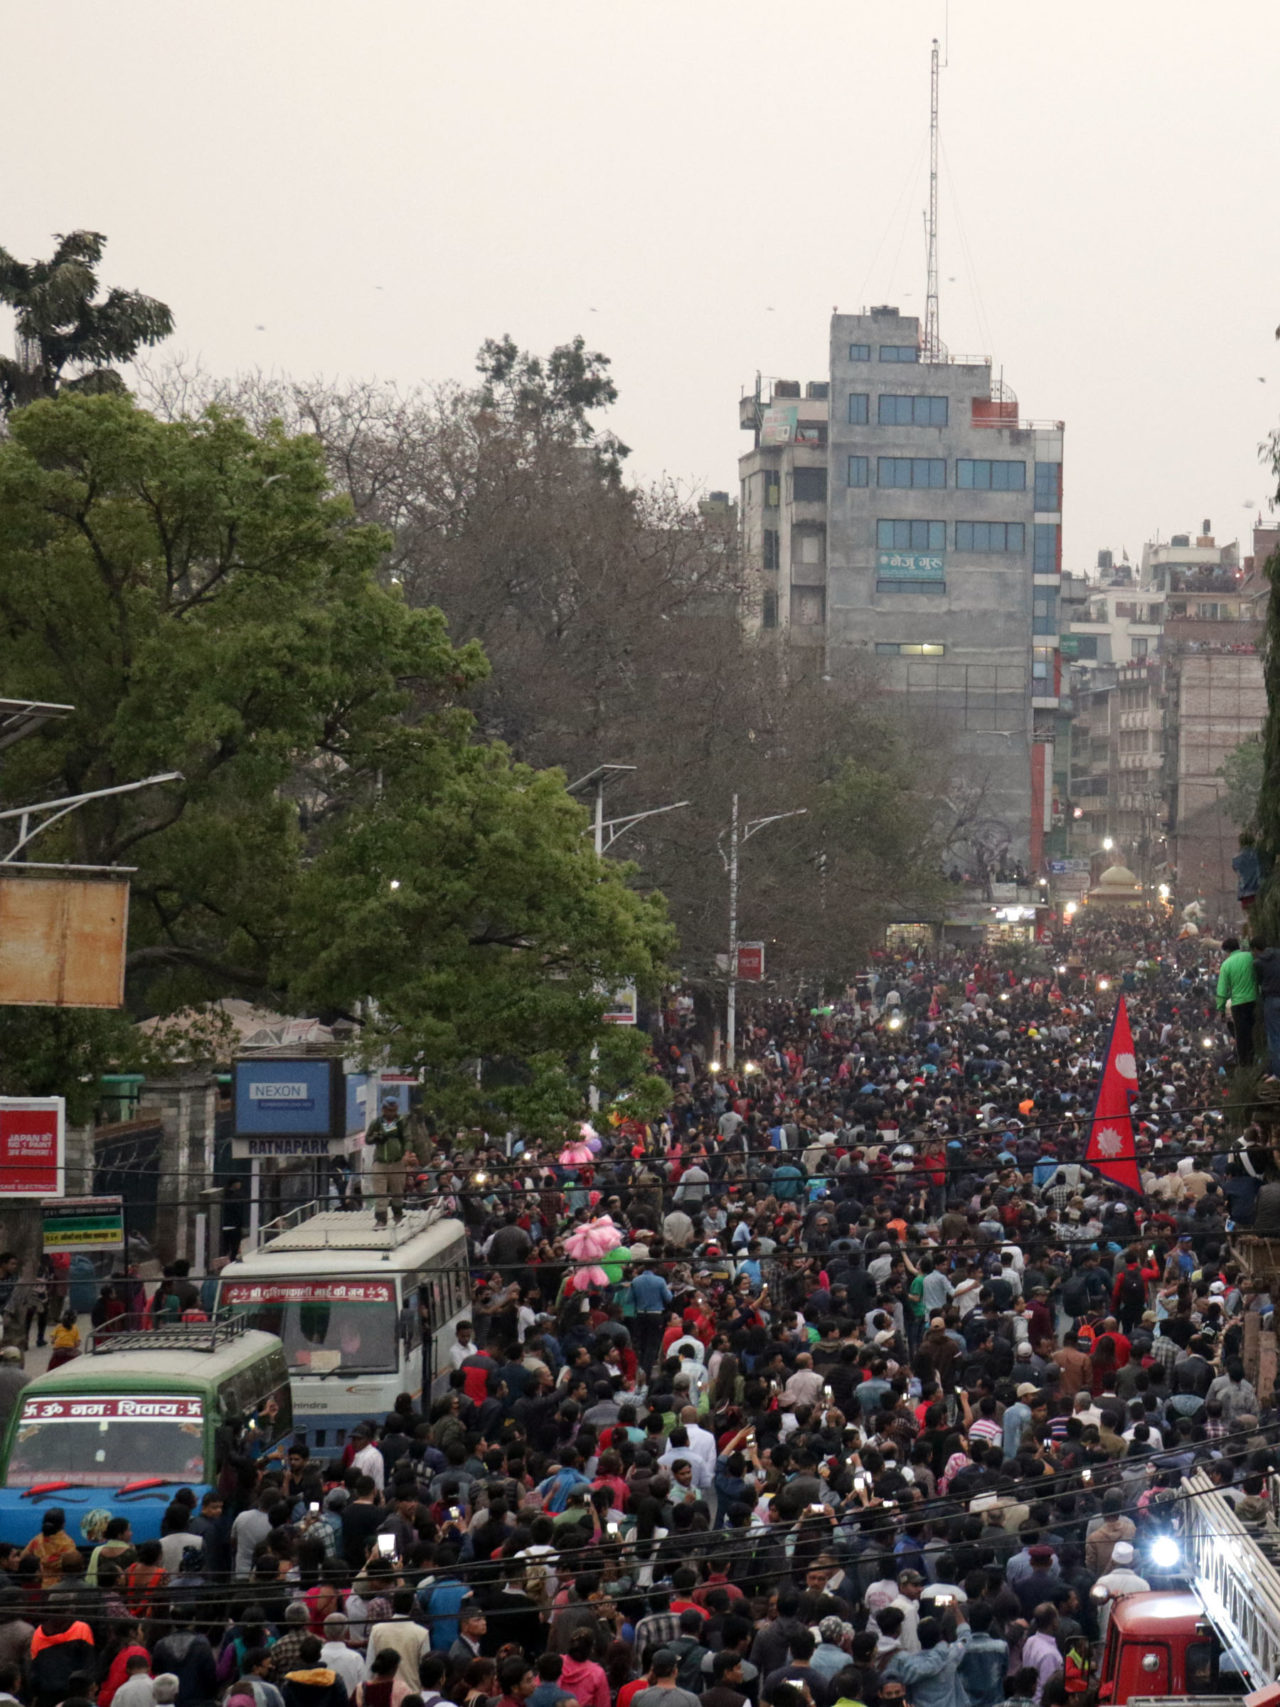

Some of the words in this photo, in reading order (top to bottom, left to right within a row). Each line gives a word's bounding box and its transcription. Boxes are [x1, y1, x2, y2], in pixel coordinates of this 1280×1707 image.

[255, 1085, 302, 1097] NEXON
[8, 1133, 40, 1142] JAPAN
[248, 1139, 330, 1155] RATNAPARK
